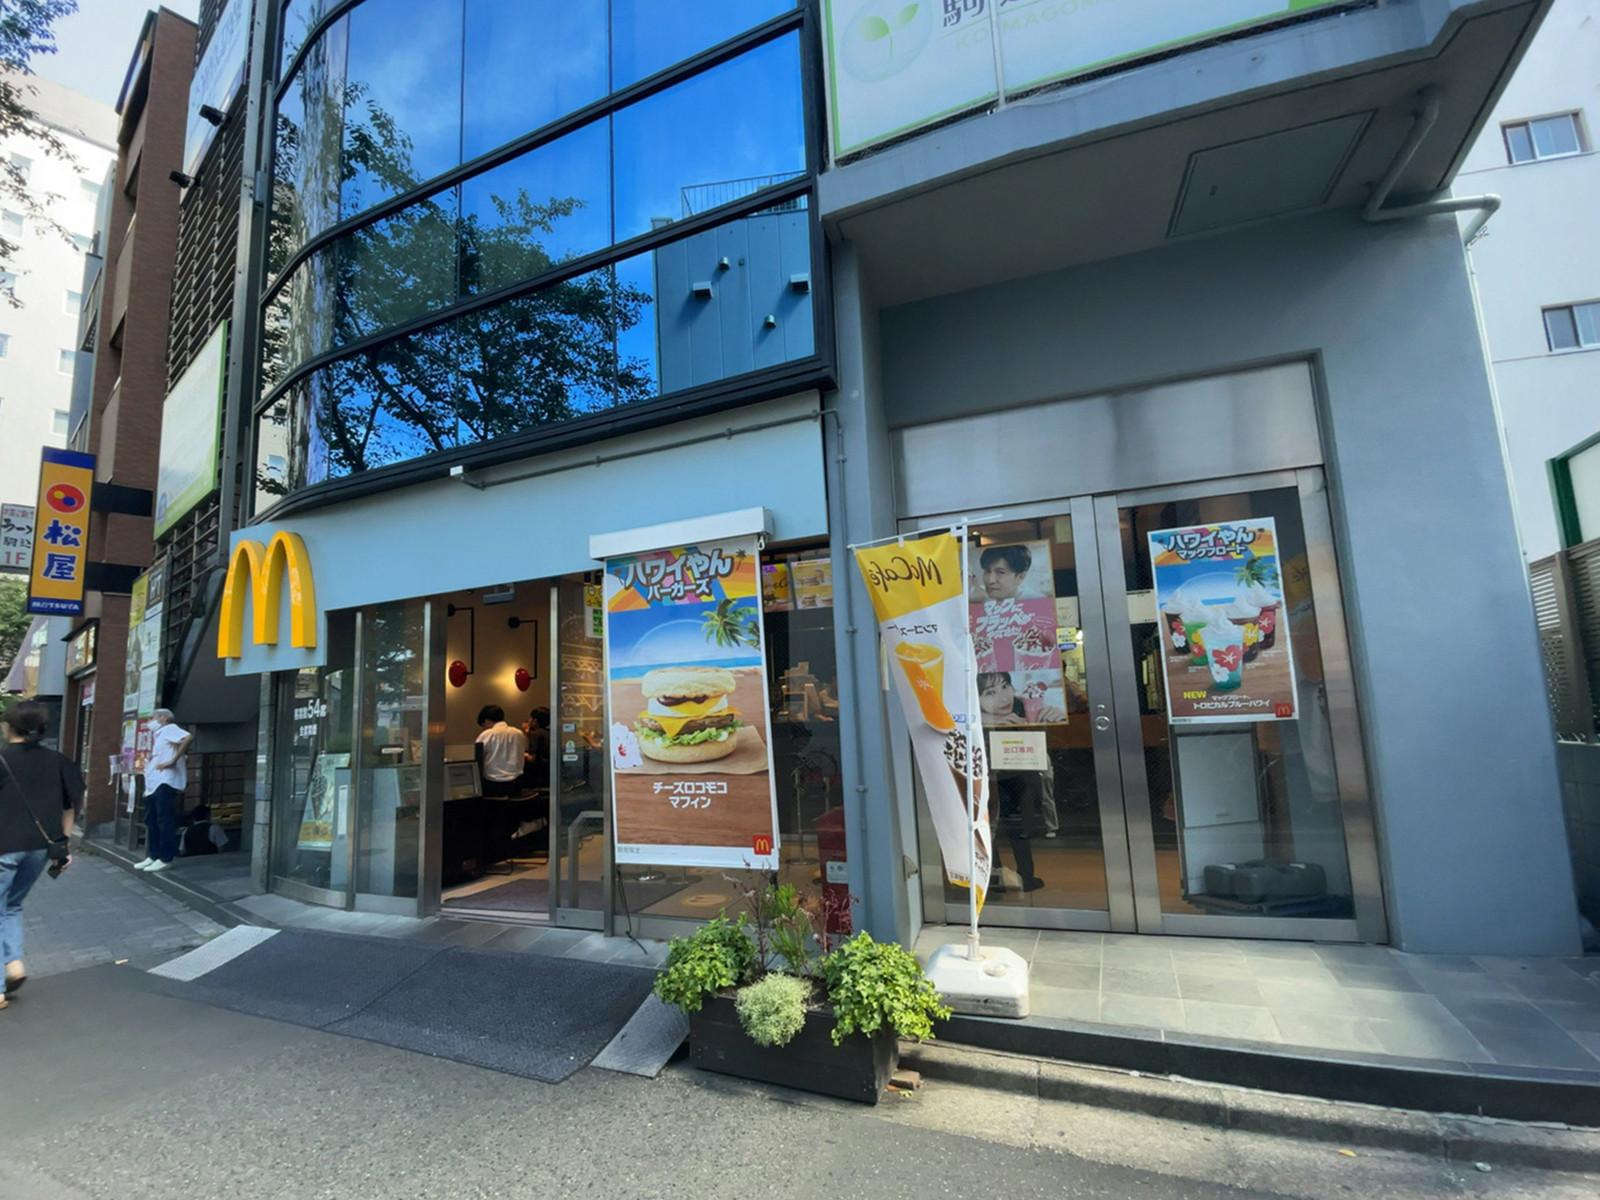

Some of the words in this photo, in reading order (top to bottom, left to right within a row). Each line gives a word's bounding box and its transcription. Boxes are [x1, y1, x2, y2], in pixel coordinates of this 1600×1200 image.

[955, 0, 1115, 48] KOMAGOM
[1167, 526, 1255, 552] ハワイやん
[43, 519, 82, 581] 松屋
[1177, 544, 1246, 559] マックフロート
[4, 551, 27, 565] 1F
[623, 549, 733, 589] ハワイやん
[647, 578, 711, 600] バーガーズ
[1183, 690, 1207, 699] NEW
[1193, 700, 1270, 709] トロピカルブルーハワイ
[653, 782, 728, 794] チーズロコモコ
[669, 796, 711, 808] マフィン
